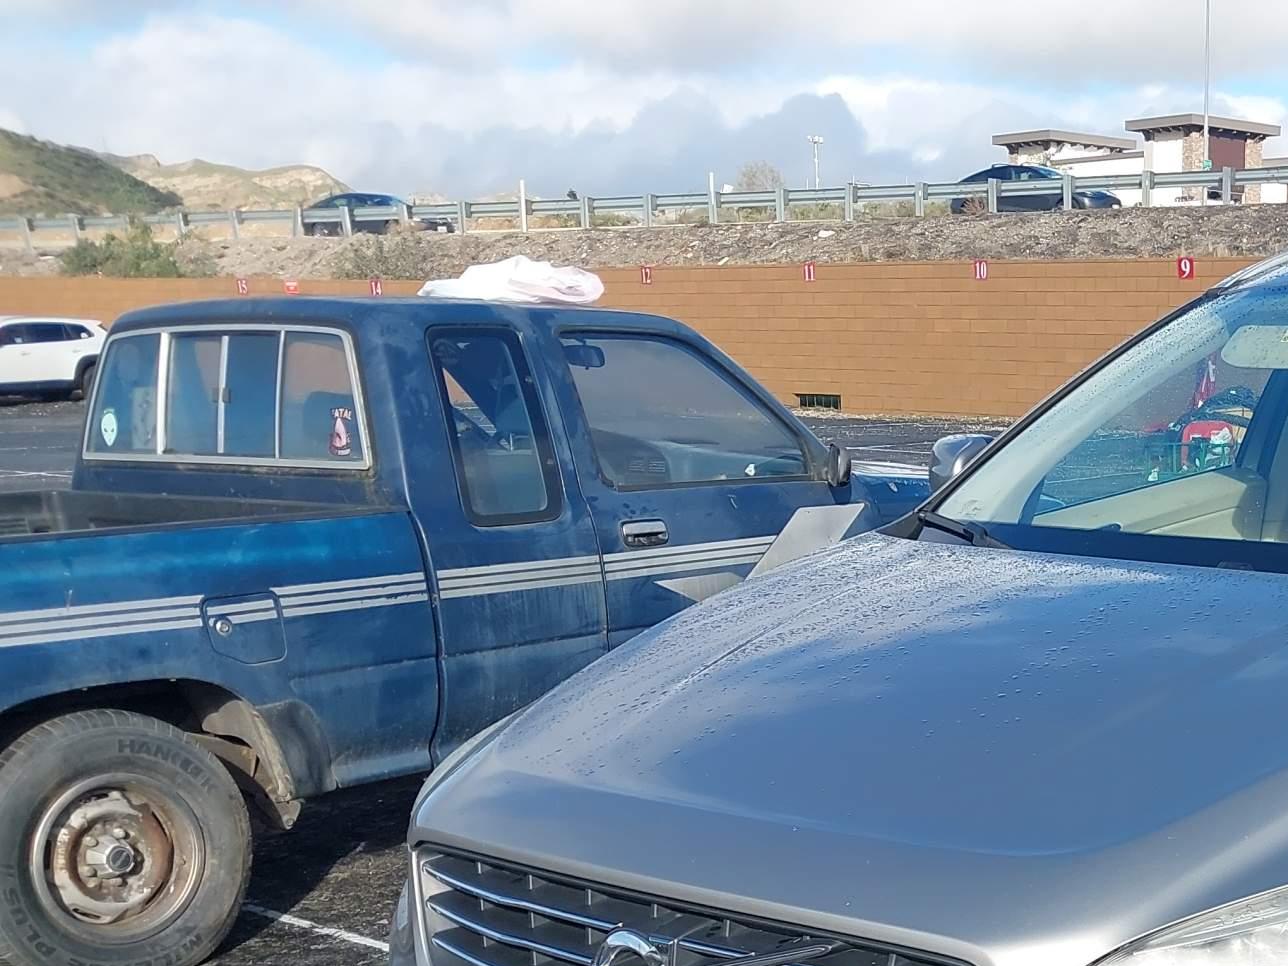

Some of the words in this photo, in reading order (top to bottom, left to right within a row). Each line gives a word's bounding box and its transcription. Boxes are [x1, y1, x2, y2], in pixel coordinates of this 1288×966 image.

[641, 267, 651, 283] 12
[804, 264, 815, 281] 11
[975, 261, 987, 279] 10
[1180, 258, 1191, 278] 9
[237, 280, 248, 294] 15
[370, 280, 382, 296] 14
[4, 886, 58, 961] PLUS
